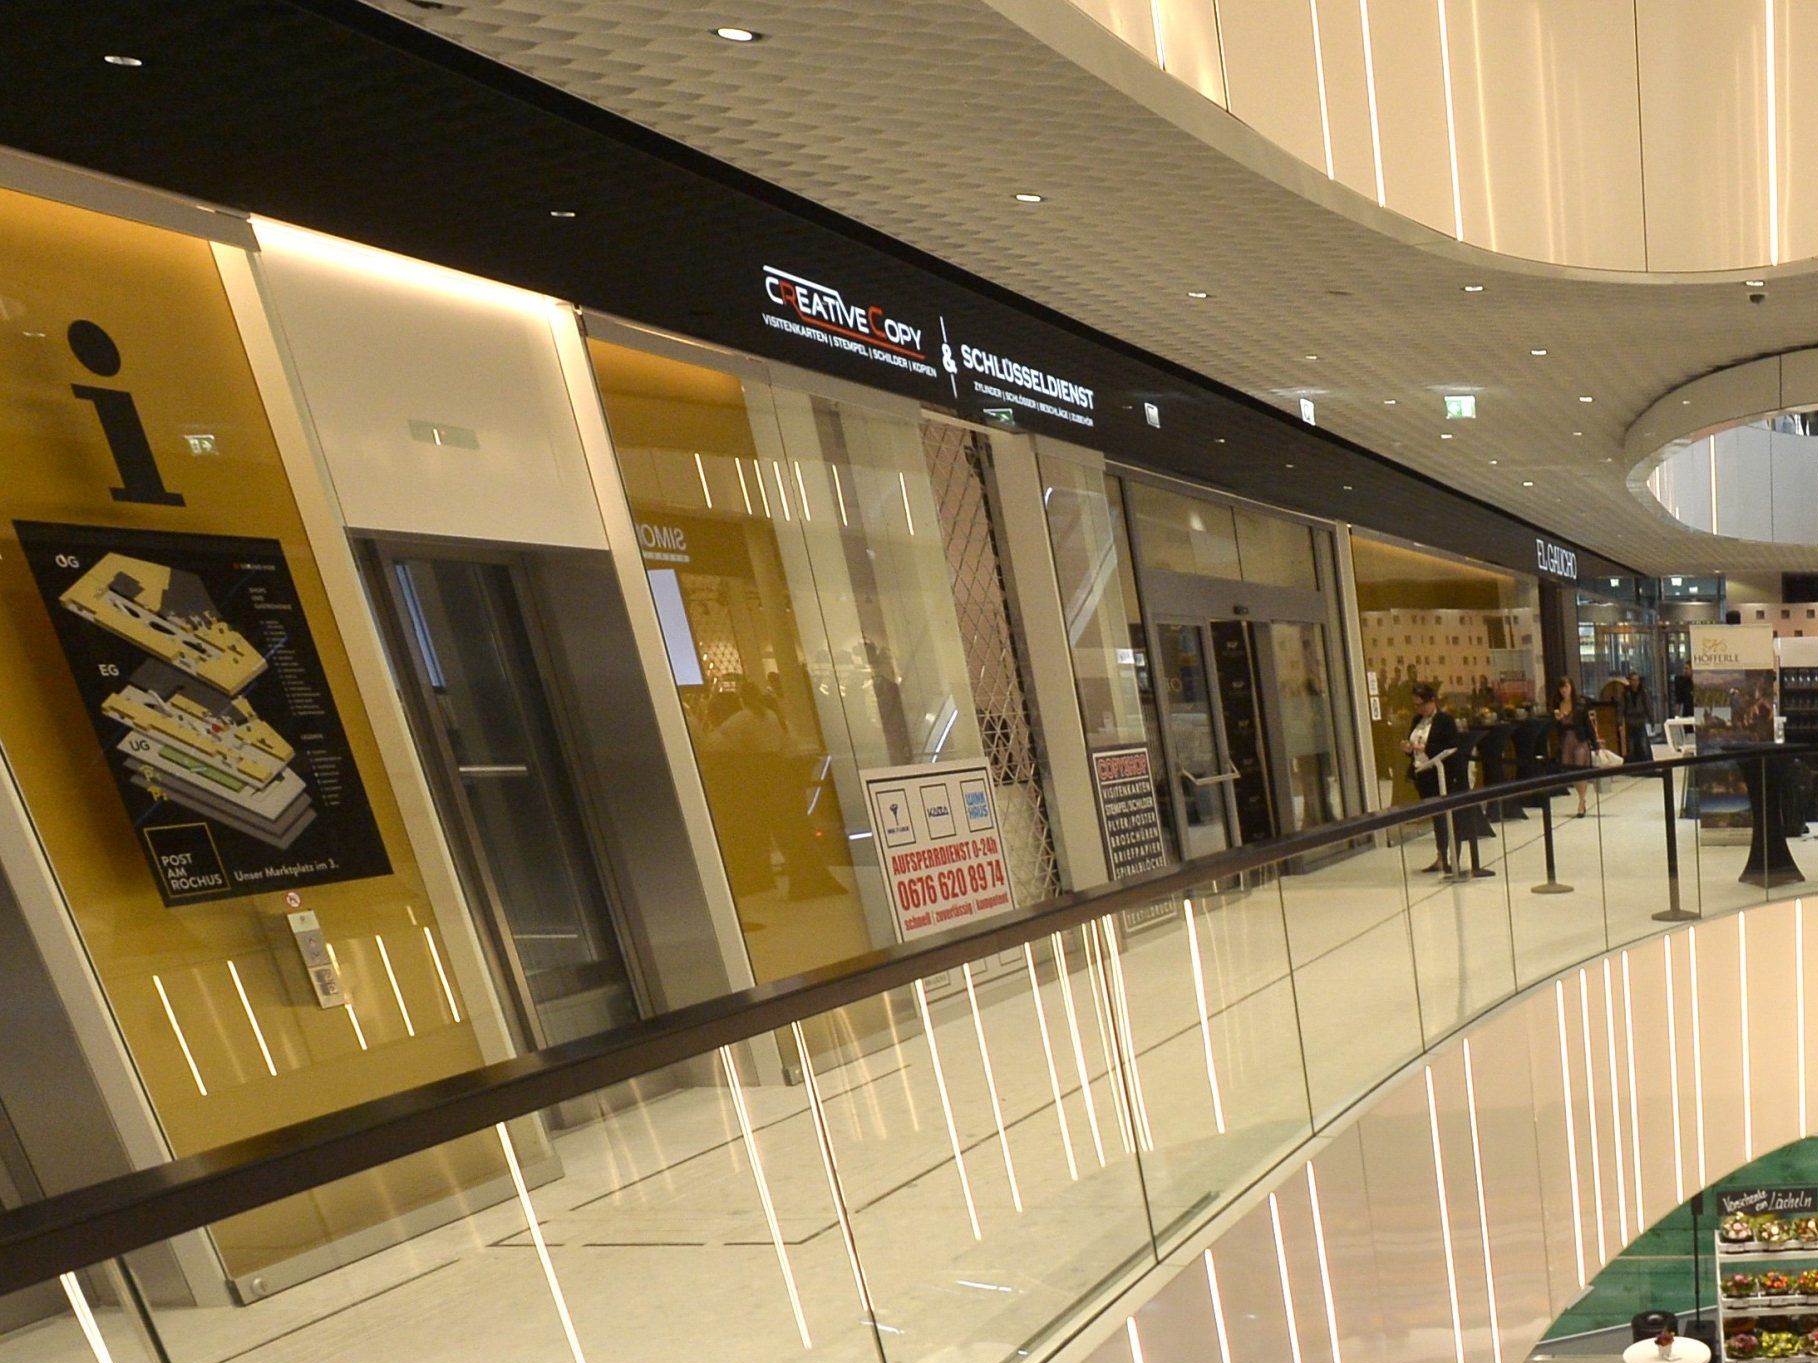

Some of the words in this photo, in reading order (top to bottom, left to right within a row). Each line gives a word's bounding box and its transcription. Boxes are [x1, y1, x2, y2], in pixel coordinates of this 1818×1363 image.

[762, 312, 828, 346] VISITENKARTEN
[833, 336, 868, 357] STEMPEL
[872, 349, 908, 369] SCHILDER
[912, 361, 937, 378] KOPIEN
[941, 343, 958, 374] &
[960, 343, 1094, 410] SCHLÜSSELDIENST
[1536, 538, 1548, 571] EL
[1547, 543, 1577, 580] GAUCHO
[98, 663, 120, 677] EG
[128, 739, 150, 751] UG
[1102, 781, 1151, 799] VISITENKARTEN
[1107, 811, 1156, 832] FLYER/POSTER
[160, 852, 193, 867] POST
[891, 841, 972, 876] AUFSPERRDIENST
[971, 837, 998, 860] 0-24h
[1113, 841, 1162, 864] BRIEFPAPIER
[167, 867, 188, 879] AM
[171, 874, 223, 890] ROCHUS
[233, 870, 264, 882] Unser
[897, 874, 938, 911] 0676
[938, 868, 967, 902] 620
[968, 863, 988, 893] 89
[988, 859, 1005, 888] 74
[904, 911, 932, 931] schnell
[976, 892, 1009, 911] kompetent
[1768, 1191, 1812, 1211] Lächeln
